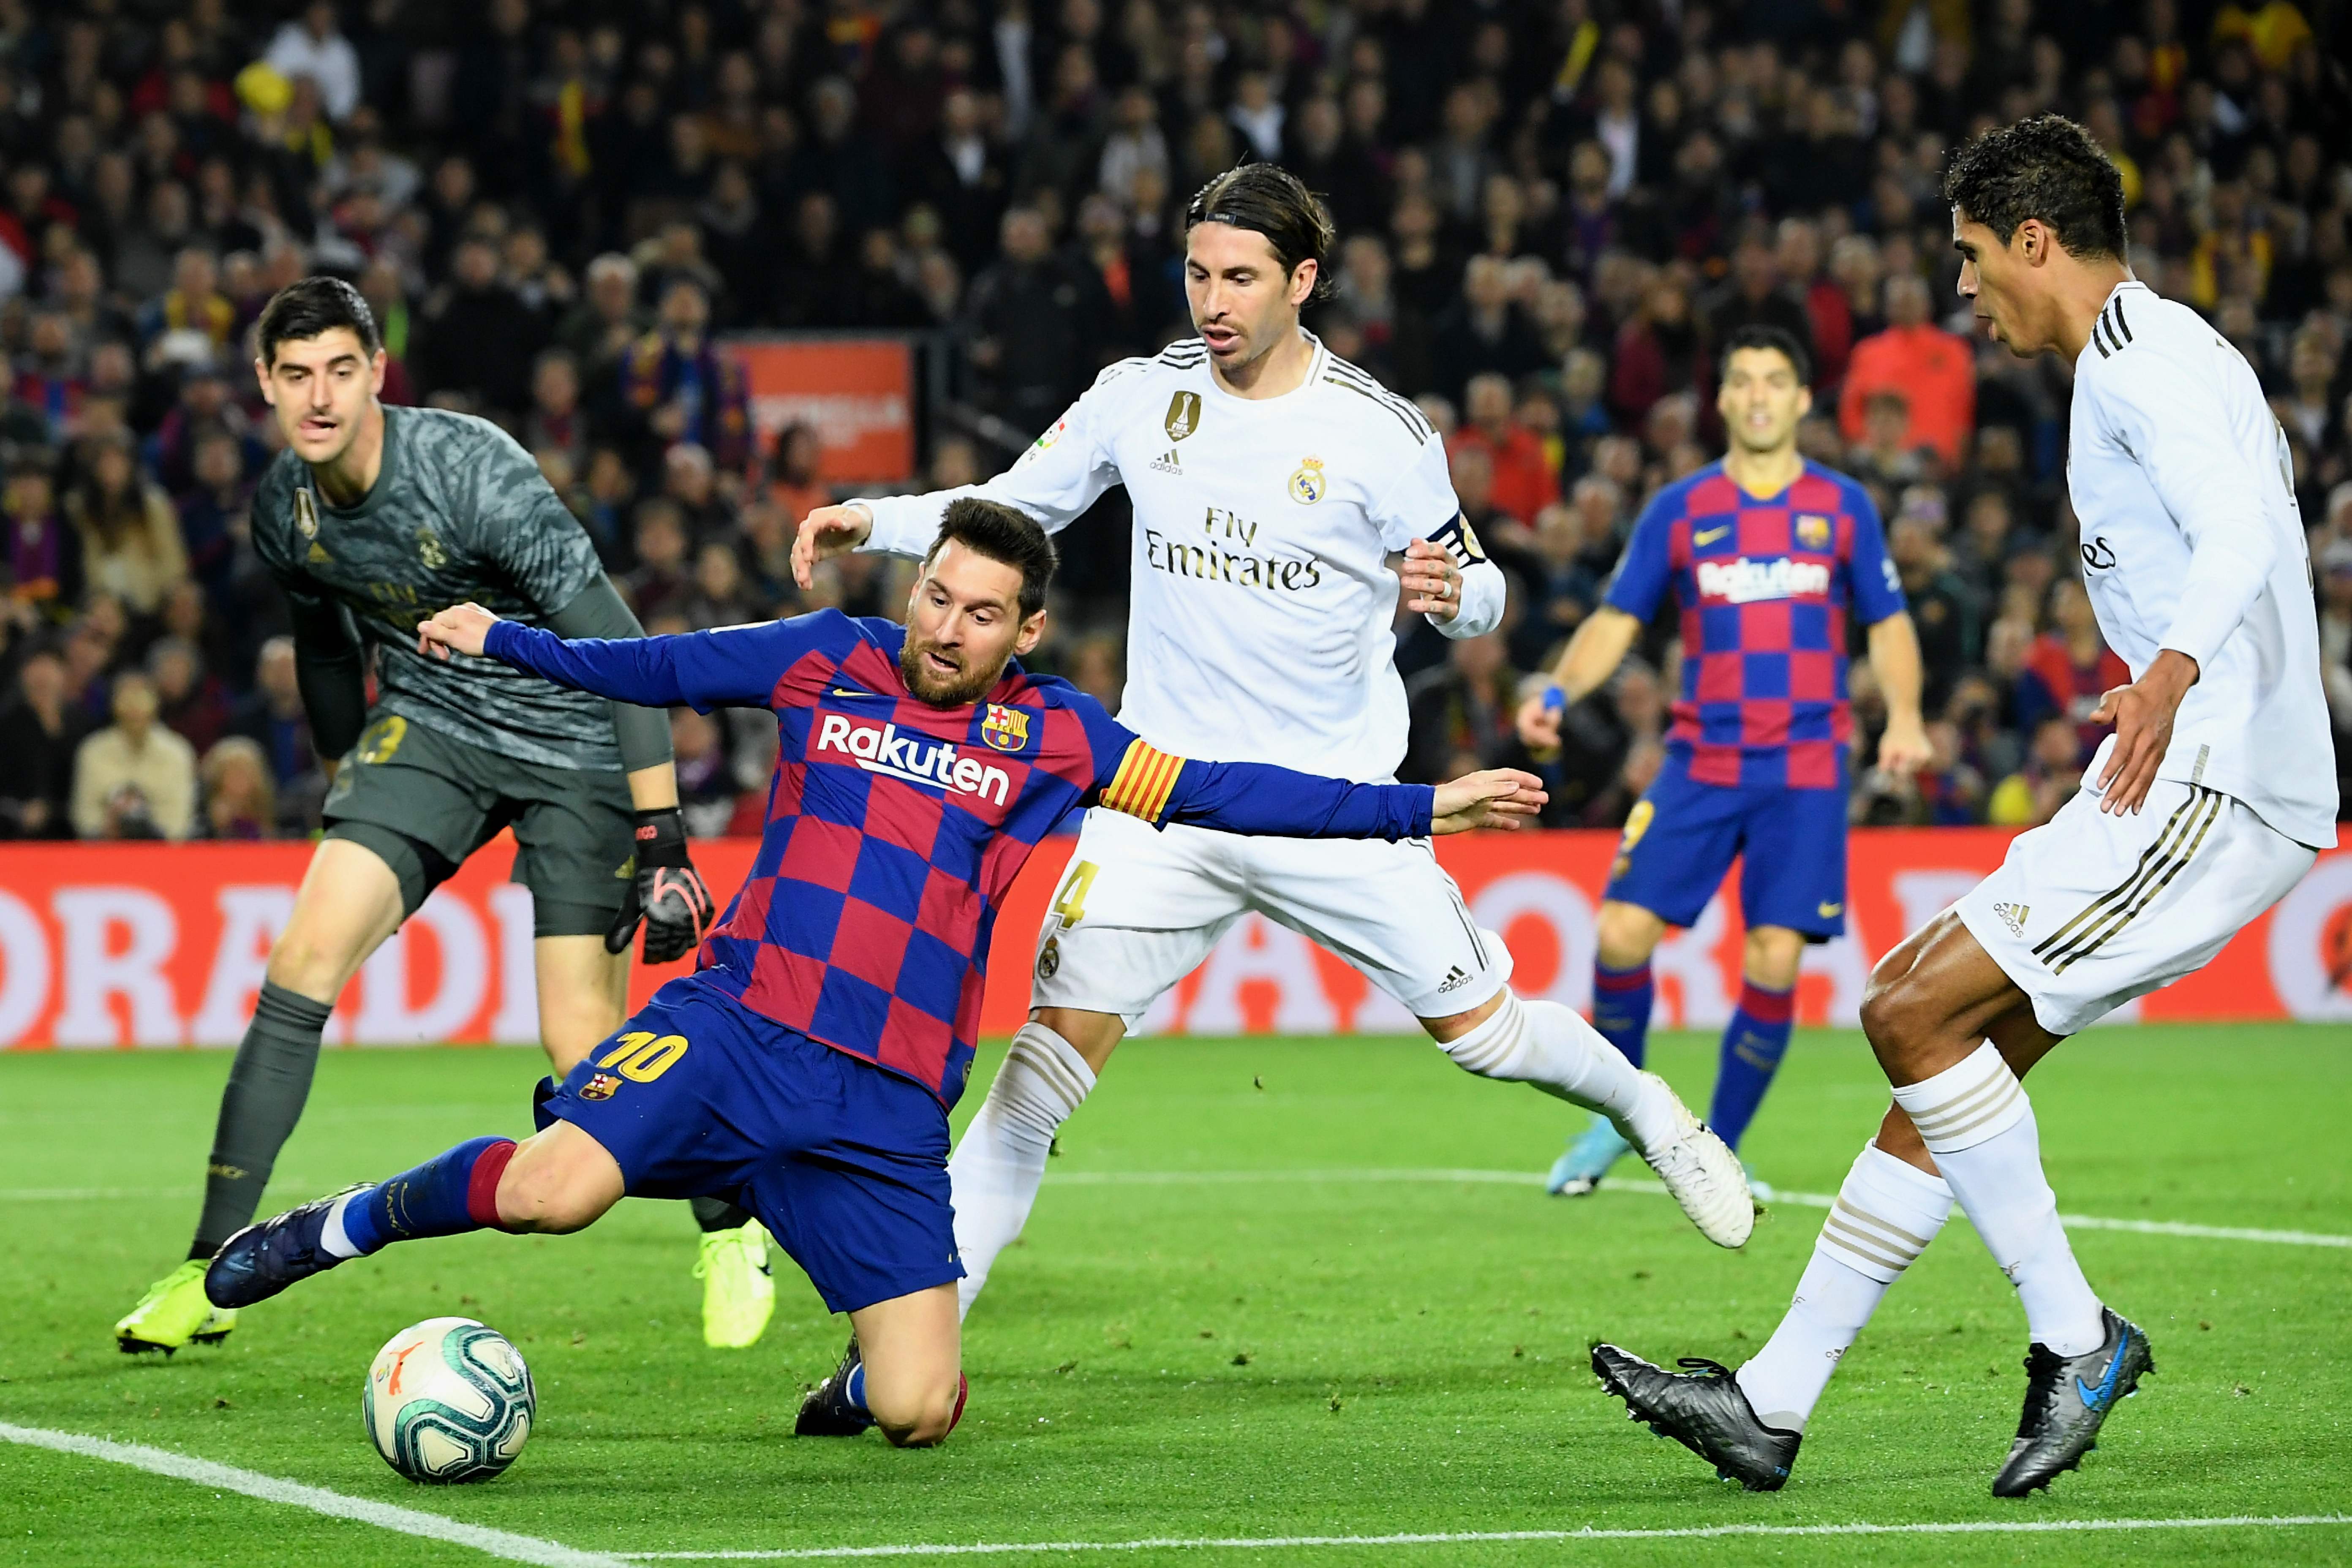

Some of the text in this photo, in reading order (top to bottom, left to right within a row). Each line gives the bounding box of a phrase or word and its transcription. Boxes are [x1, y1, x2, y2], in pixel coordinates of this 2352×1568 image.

[1150, 462, 1183, 475] adidas
[1205, 507, 1257, 547] Fly
[1145, 528, 1320, 591] Emirates
[2082, 537, 2116, 576] es
[817, 715, 1010, 806] Rakuten
[1051, 860, 1100, 931] 4
[1993, 903, 2024, 938] adidas
[1437, 973, 1473, 993] adidas
[596, 1031, 689, 1083] 10
